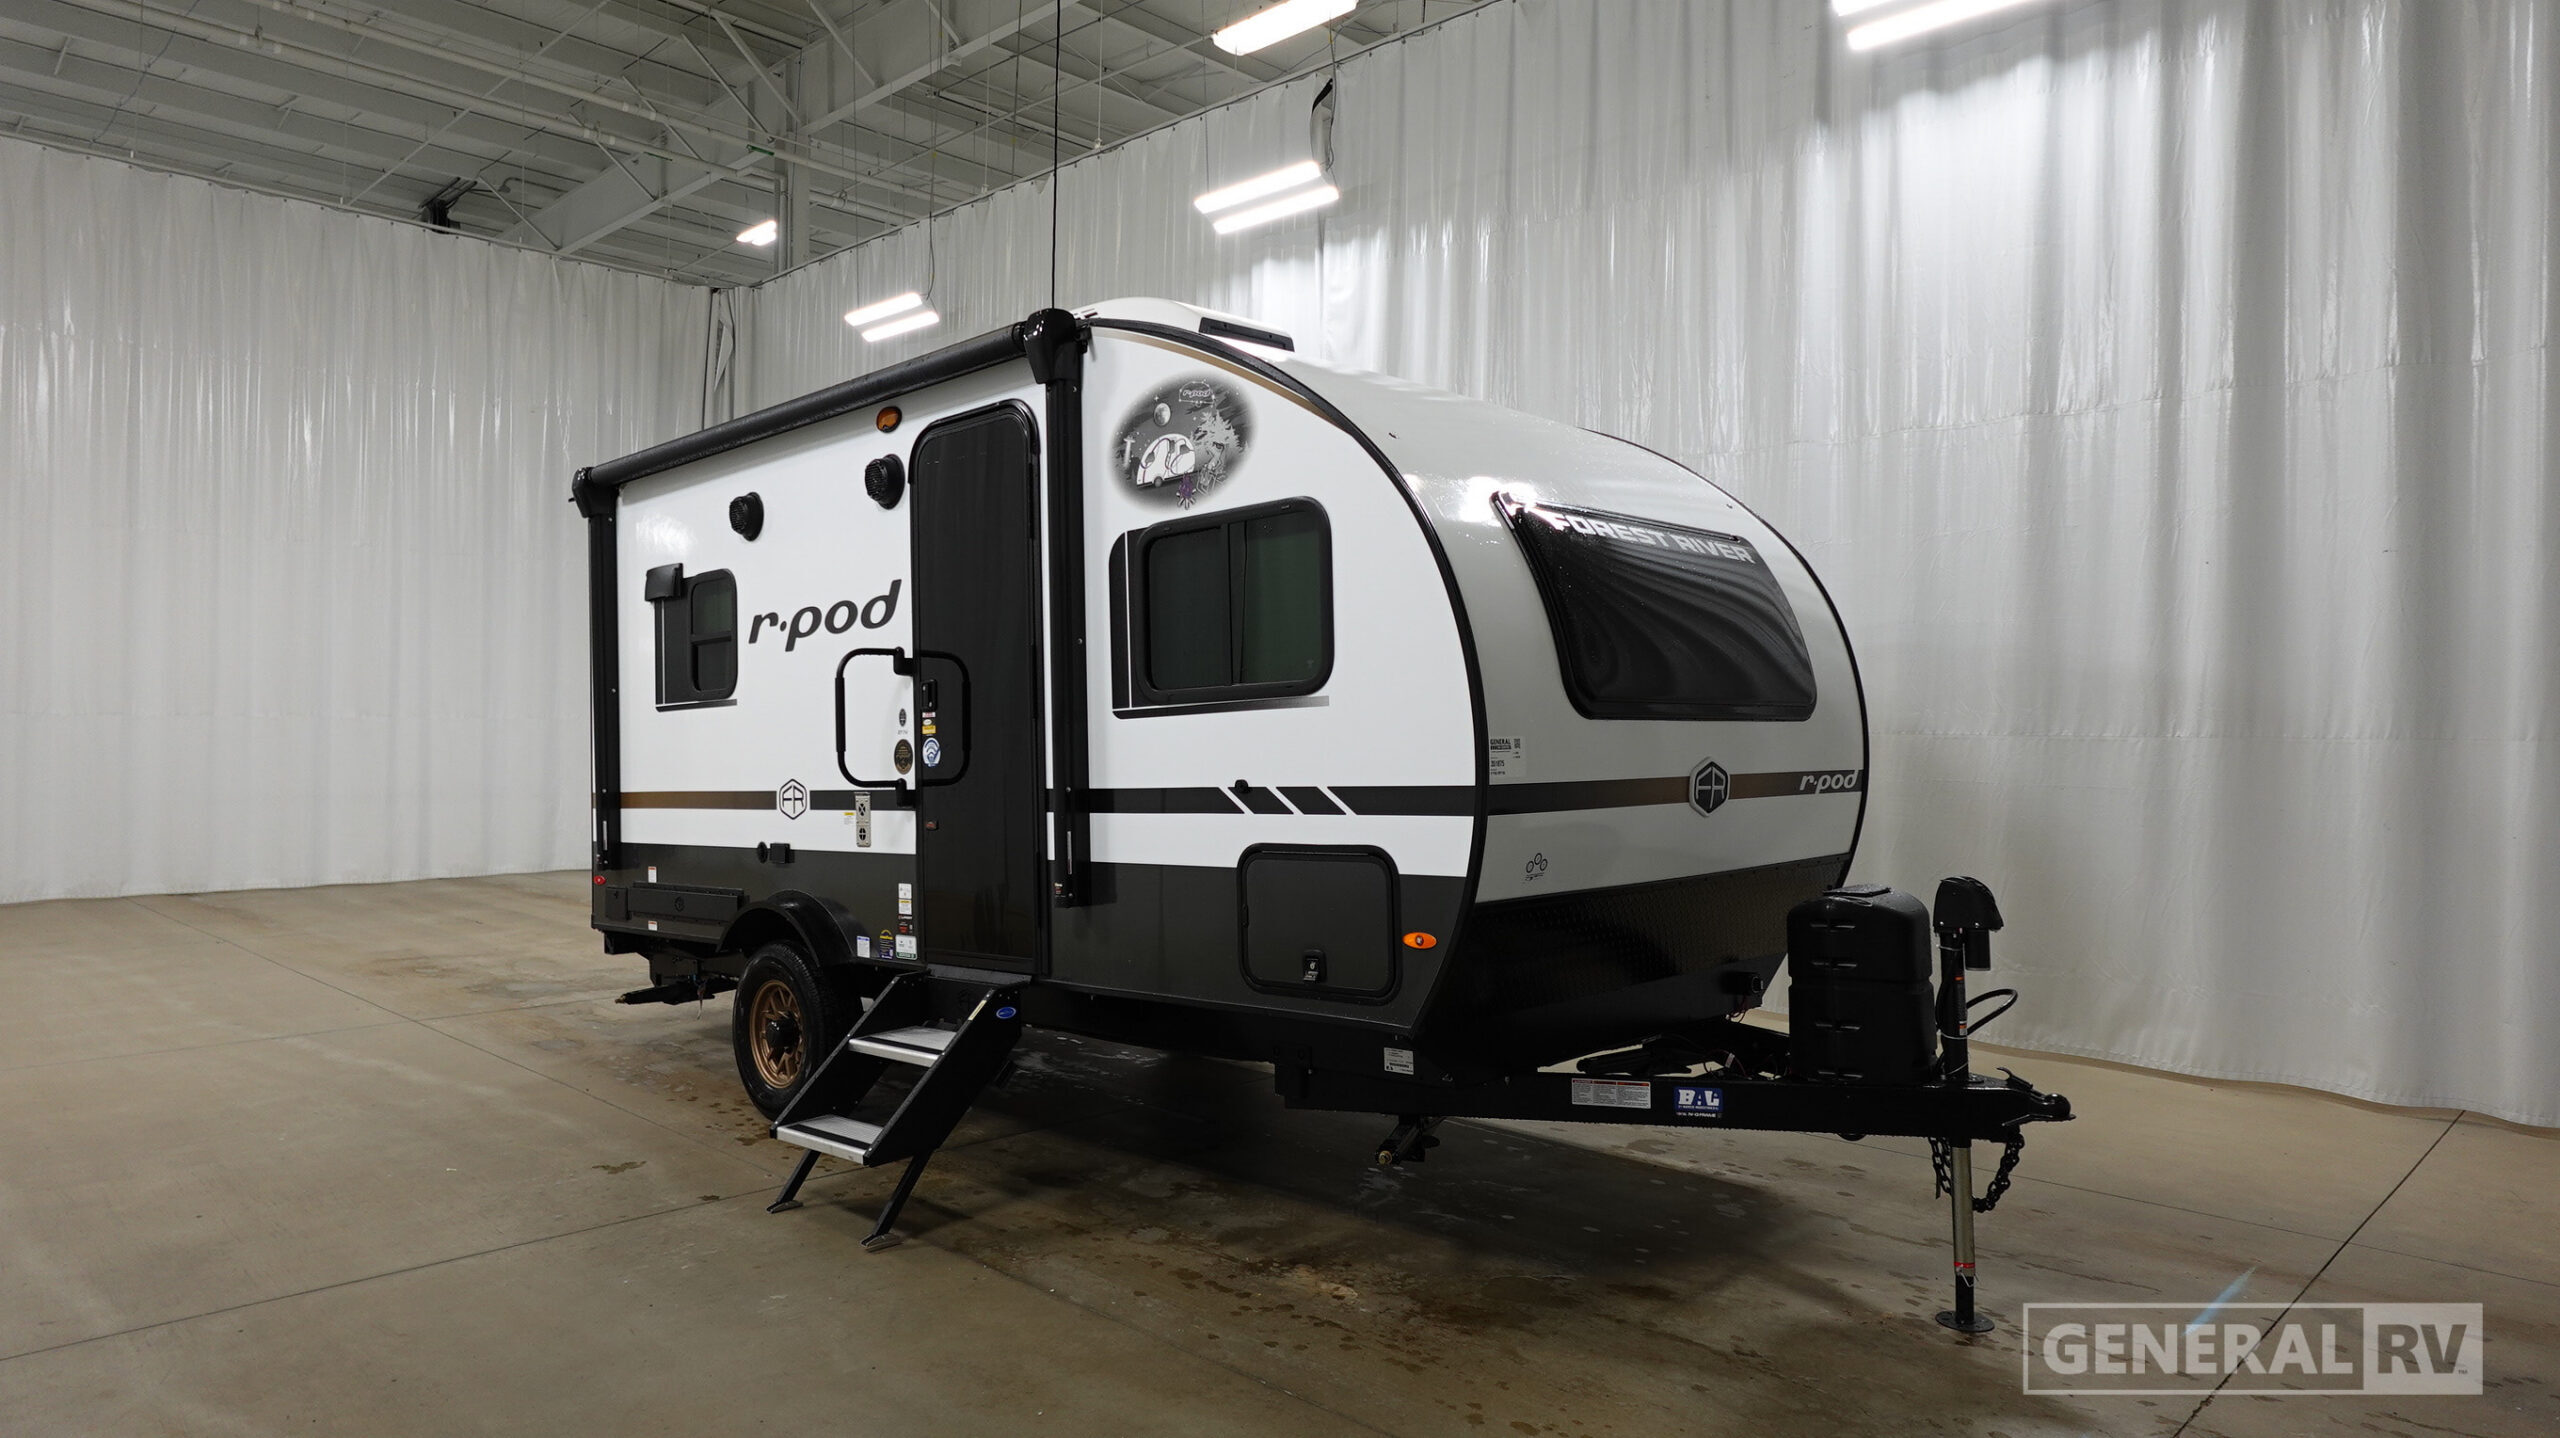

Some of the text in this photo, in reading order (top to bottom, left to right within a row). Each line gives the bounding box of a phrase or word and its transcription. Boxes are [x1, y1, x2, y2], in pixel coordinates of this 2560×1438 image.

[1549, 511, 1756, 563] FOREST RIVER
[1678, 1089, 1720, 1106] BAL
